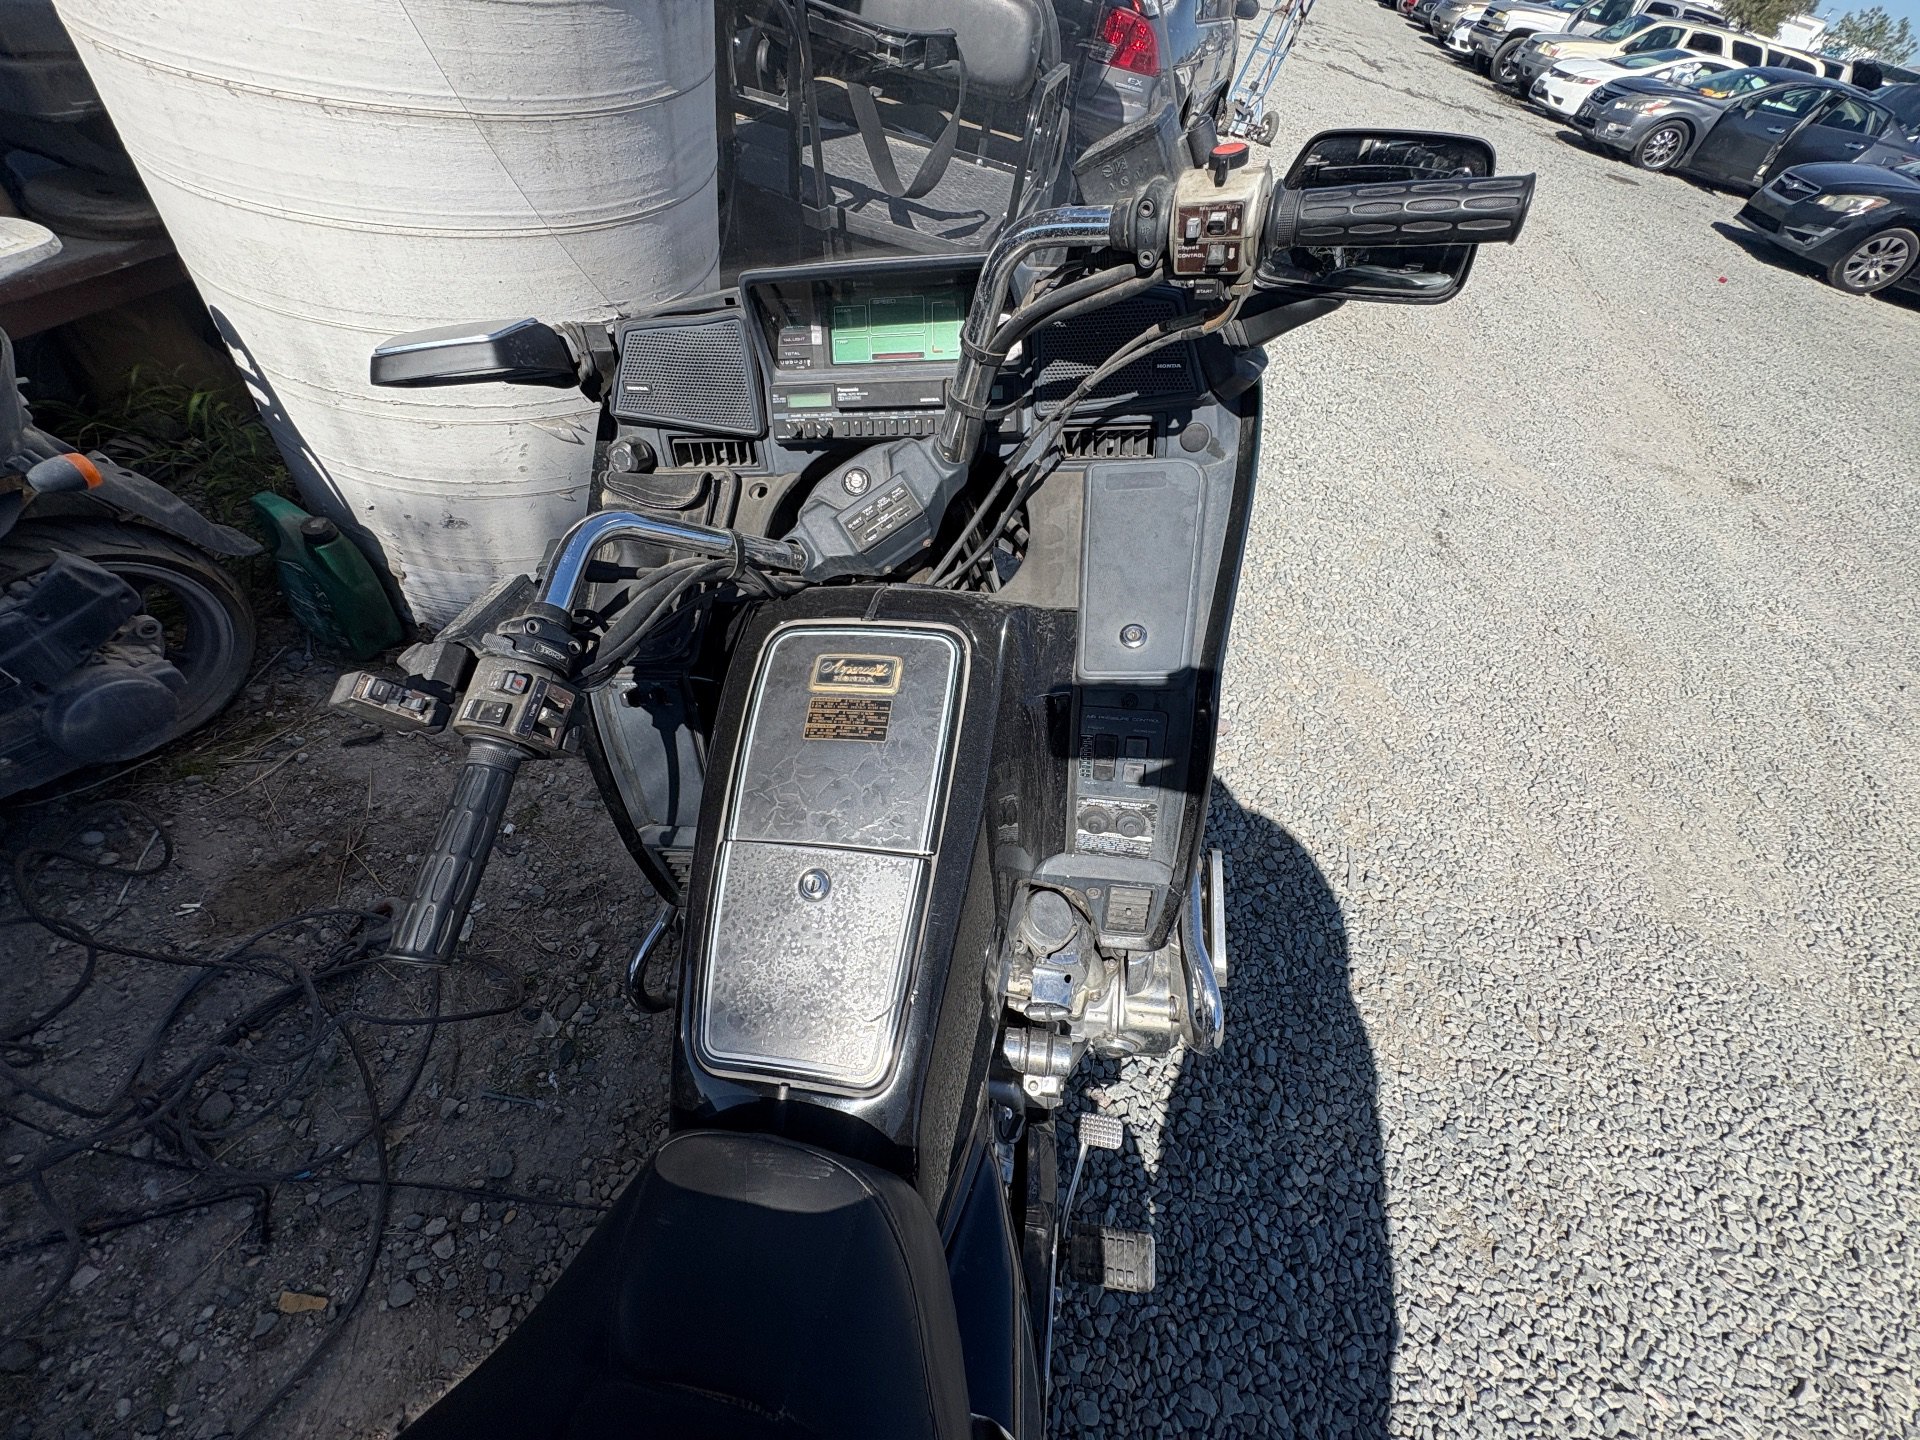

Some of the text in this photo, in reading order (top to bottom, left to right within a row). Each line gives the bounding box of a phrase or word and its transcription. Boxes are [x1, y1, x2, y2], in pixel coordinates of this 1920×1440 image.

[1128, 77, 1143, 86] EX
[1141, 227, 1151, 235] UP
[540, 646, 562, 660] CHOKE
[832, 675, 875, 684] HONDA
